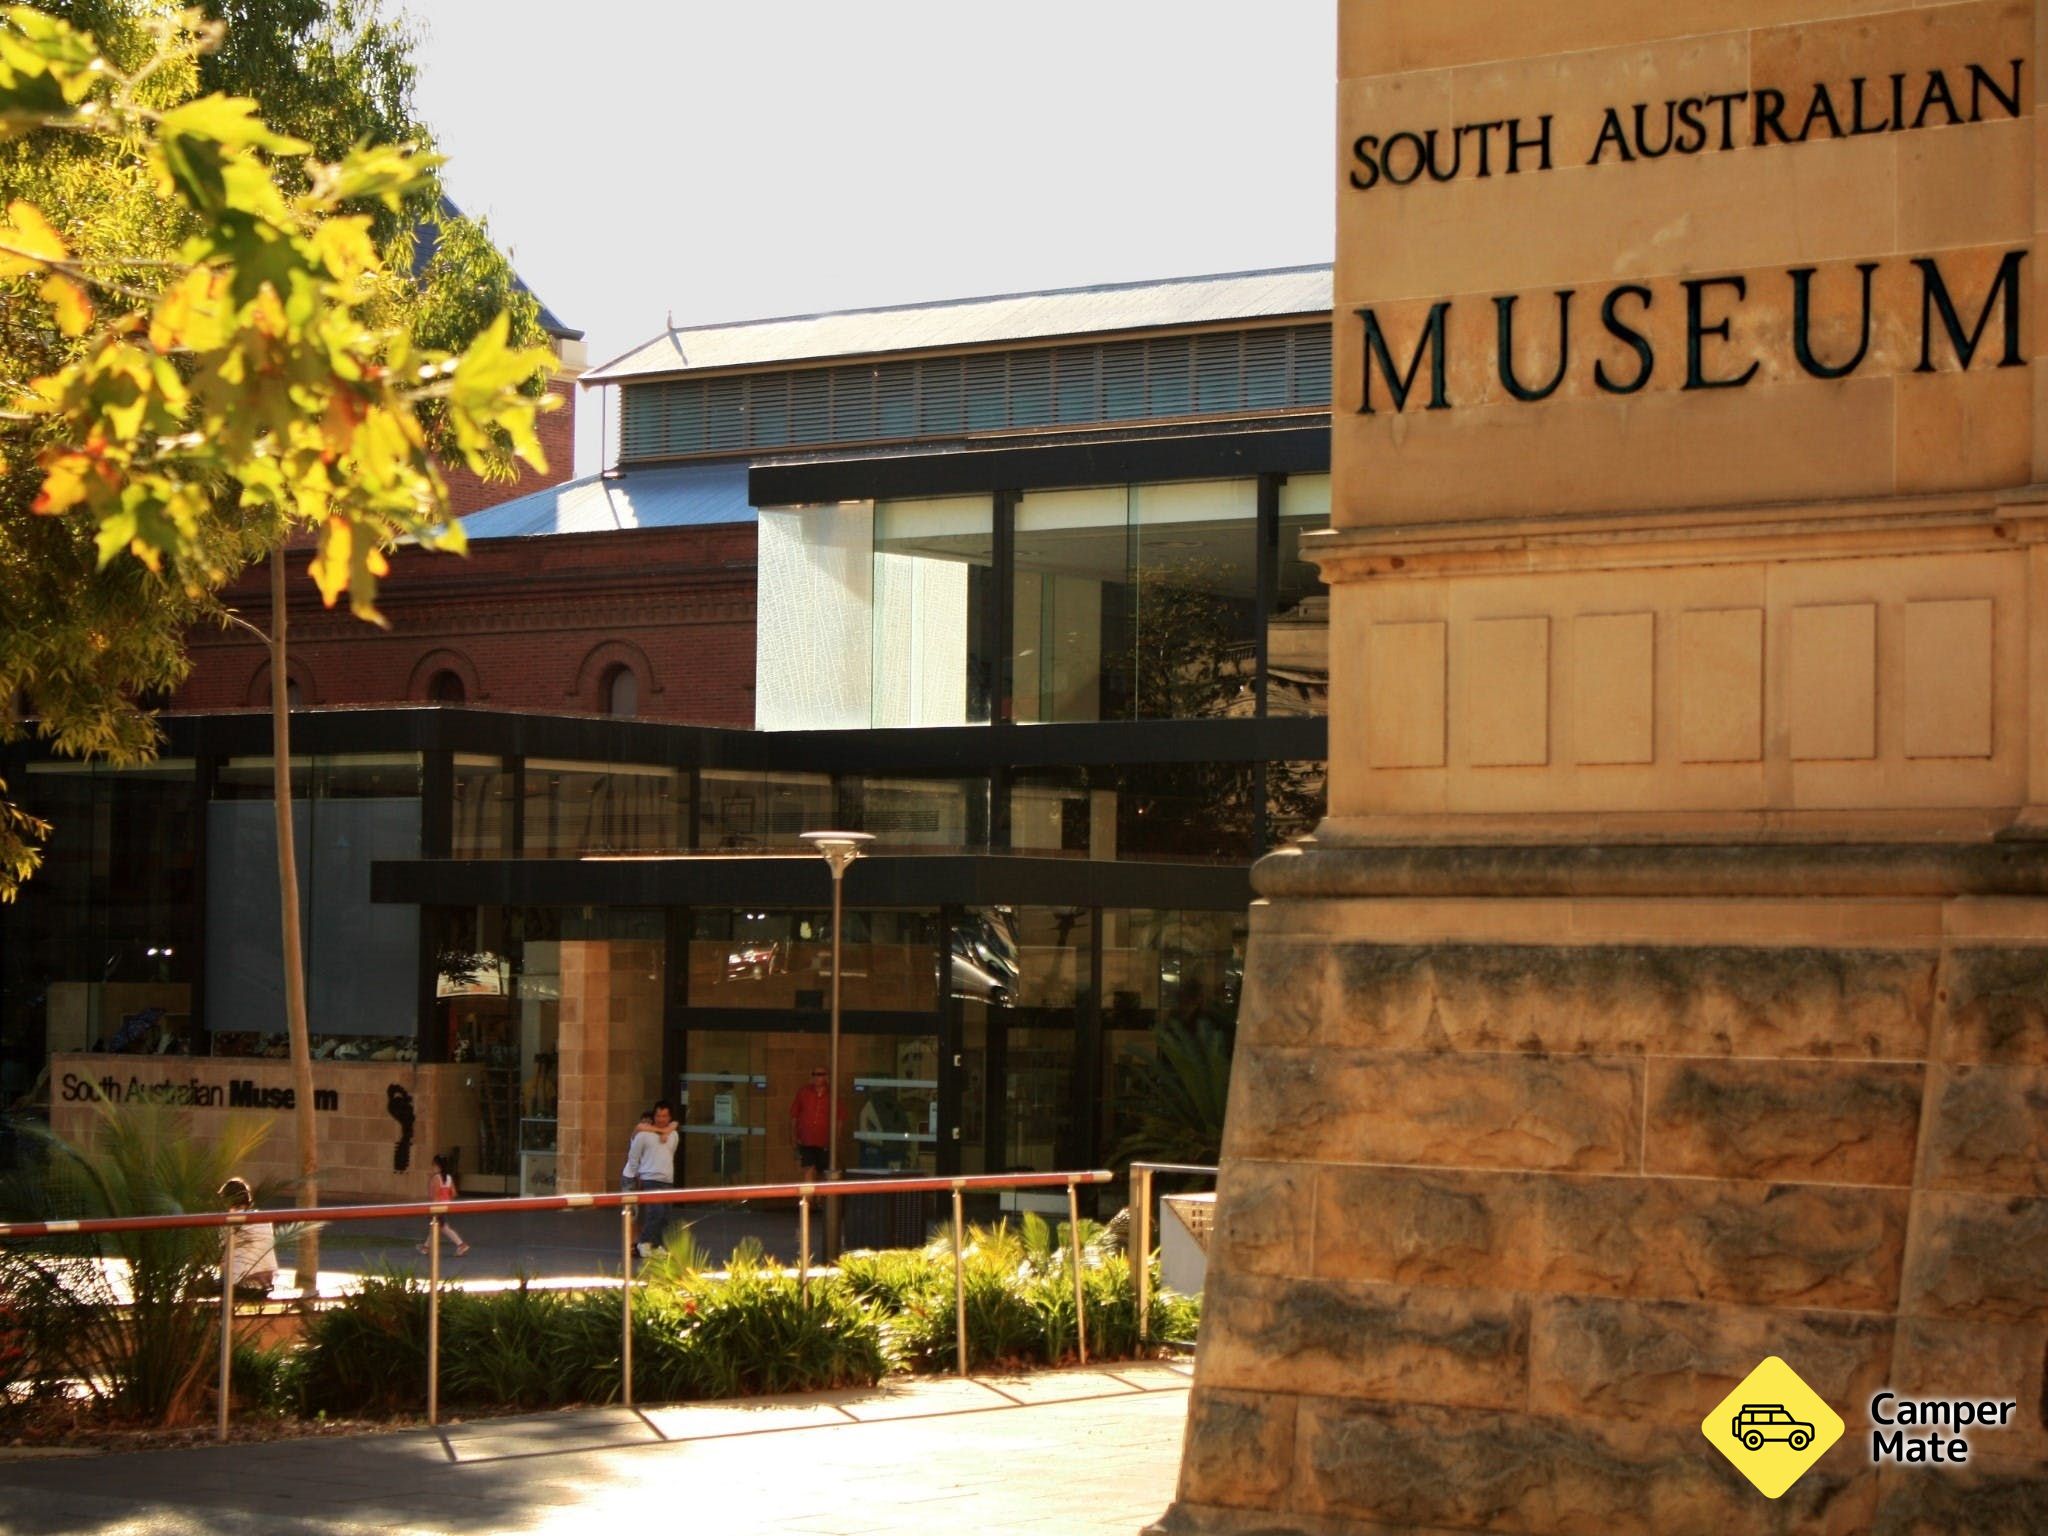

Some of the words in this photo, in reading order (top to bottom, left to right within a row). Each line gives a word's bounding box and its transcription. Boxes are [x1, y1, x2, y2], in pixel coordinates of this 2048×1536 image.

[1350, 115, 1553, 190] SOUTH
[1586, 58, 2024, 165] AUSTRALIAN
[1354, 250, 2028, 414] MUSEUM
[229, 1080, 338, 1111] Musem
